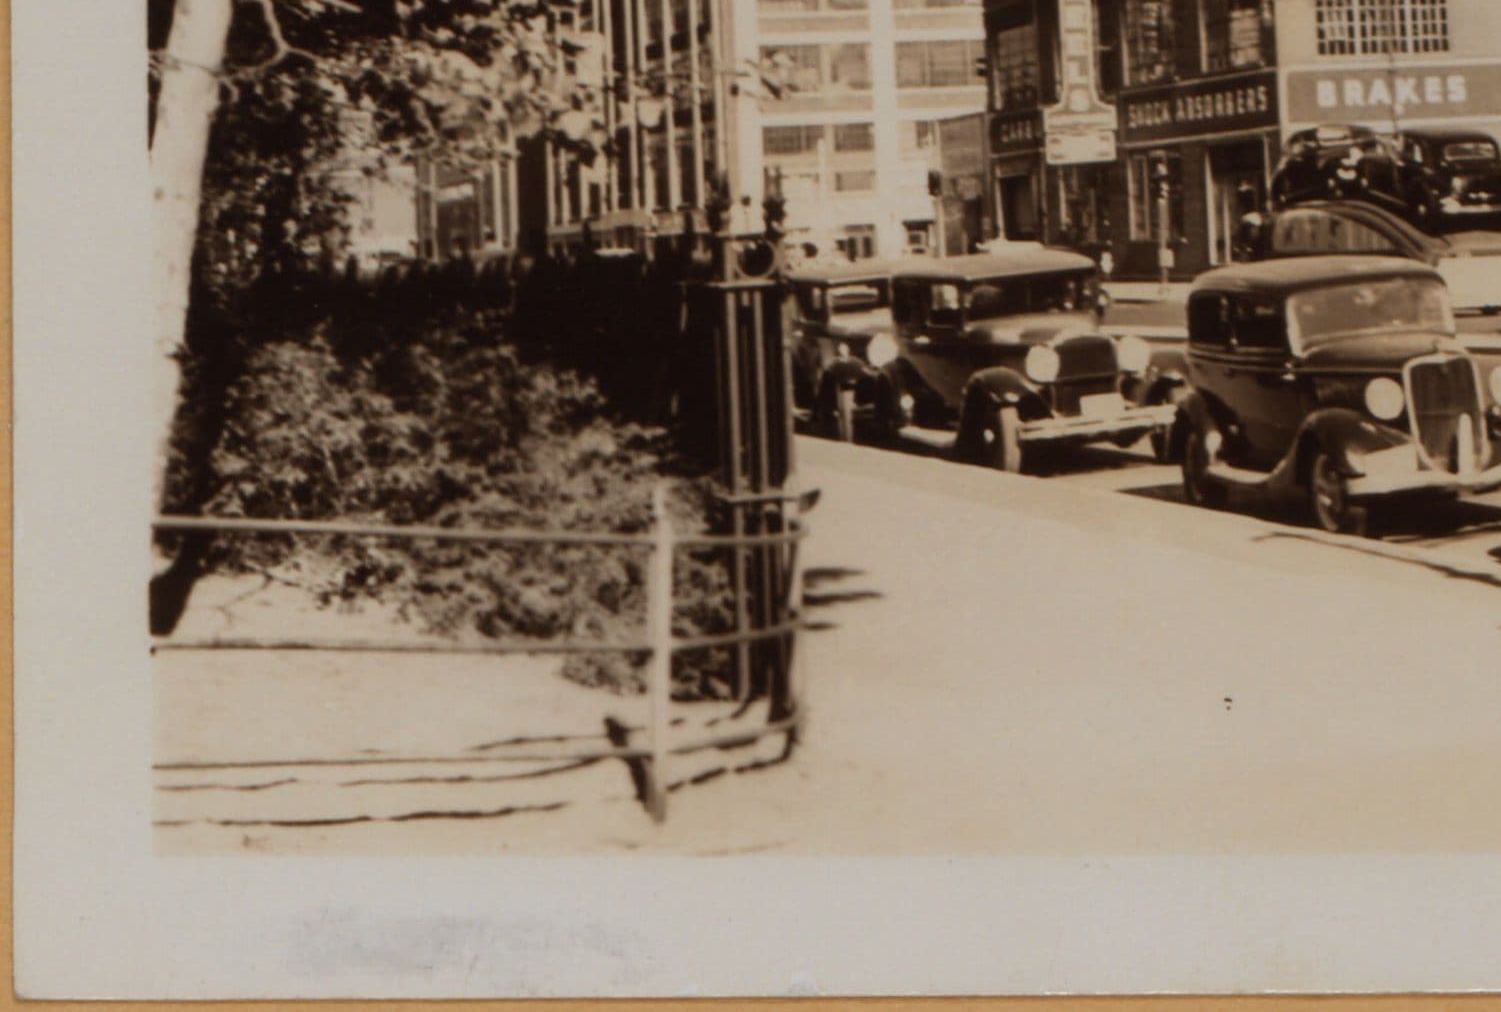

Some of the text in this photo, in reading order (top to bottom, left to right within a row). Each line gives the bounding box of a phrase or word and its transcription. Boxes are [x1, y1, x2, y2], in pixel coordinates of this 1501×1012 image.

[1128, 85, 1268, 129] SHOCK ABSORBERS
[1316, 75, 1467, 109] BRAKES
